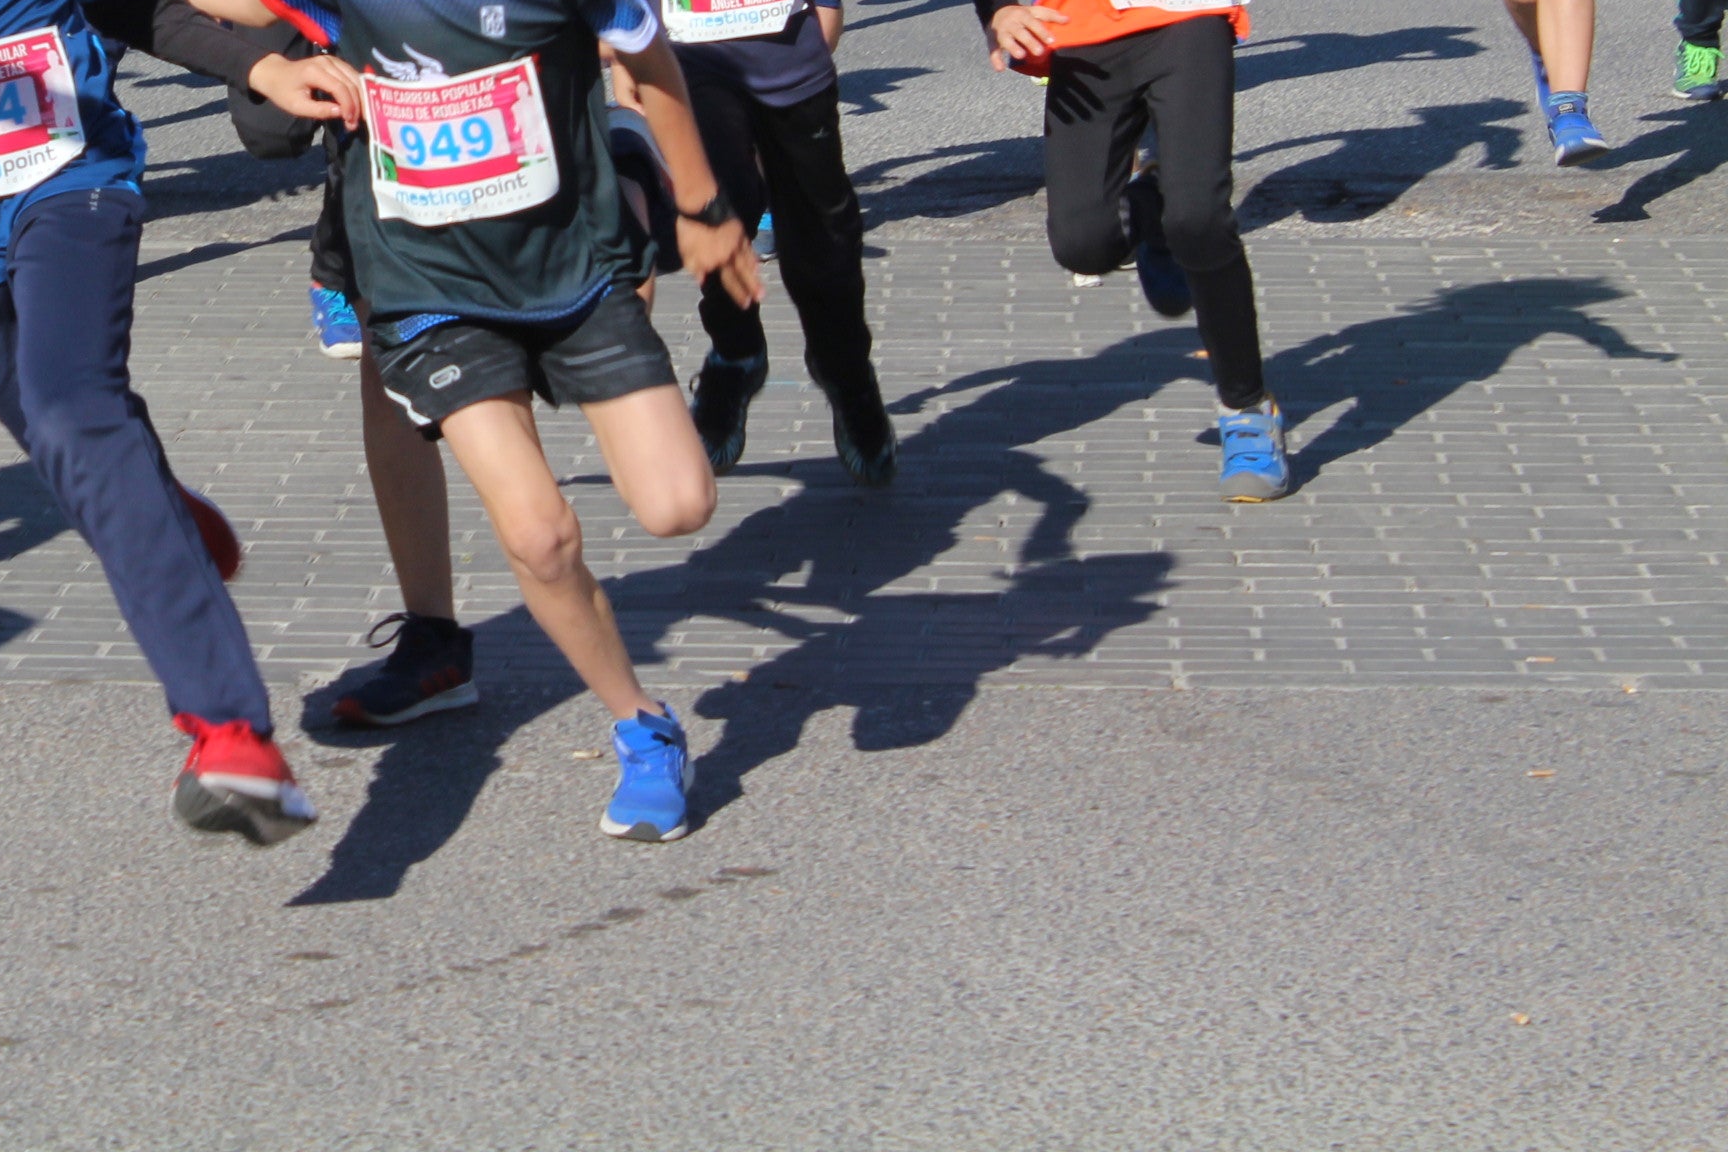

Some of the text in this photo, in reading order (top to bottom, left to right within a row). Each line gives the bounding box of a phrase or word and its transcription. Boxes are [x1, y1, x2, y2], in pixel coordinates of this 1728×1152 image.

[393, 89, 441, 105] CARRERA
[440, 75, 495, 102] POPULAR
[382, 93, 494, 121] CIUDAD DE ROQUETAS
[399, 115, 494, 167] 949
